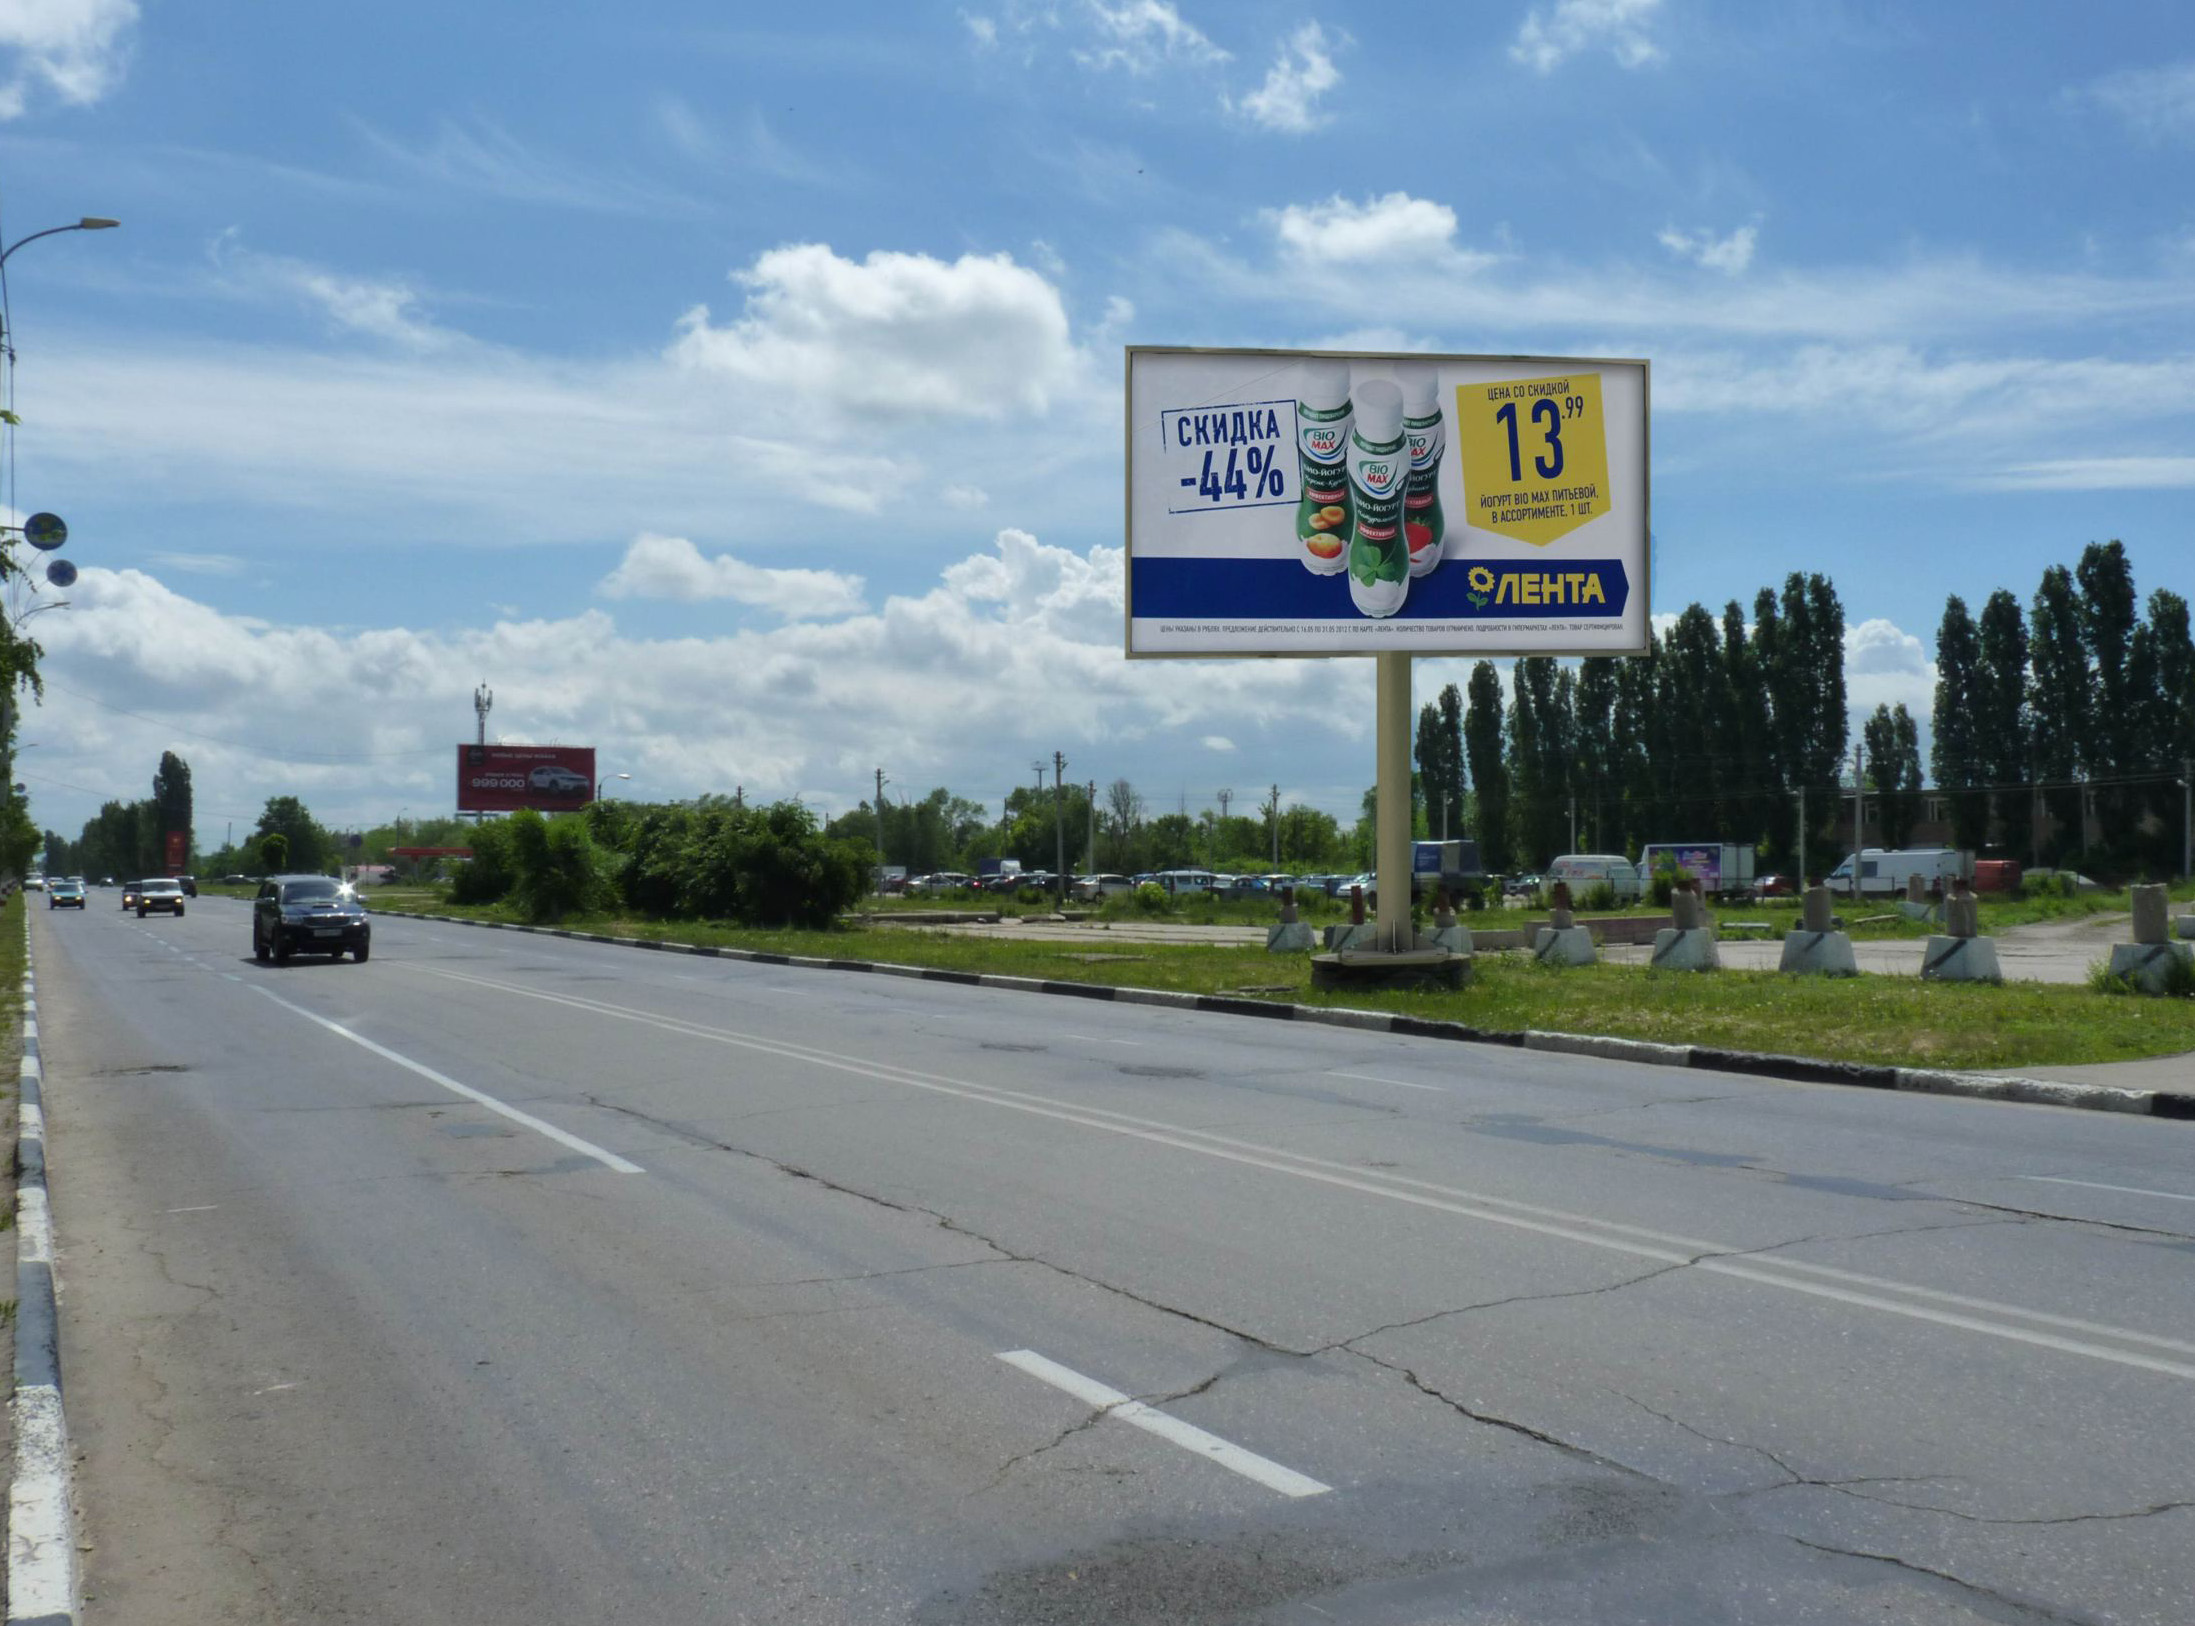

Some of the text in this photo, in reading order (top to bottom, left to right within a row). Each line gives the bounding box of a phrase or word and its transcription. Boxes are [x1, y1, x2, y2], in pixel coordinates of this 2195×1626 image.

[1487, 379, 1570, 402] ЦЕНА СО СКИДКОЙ
[1177, 409, 1281, 447] СКИДКА
[1313, 430, 1335, 441] BIO
[1311, 441, 1335, 450] MAX
[1496, 398, 1564, 482] 13
[1180, 444, 1284, 502] -44%
[1367, 474, 1388, 484] MAX
[1369, 464, 1388, 475] BIO
[1480, 483, 1599, 509] ЙОГУРТ BIO MAX ПИТЬЕВОЙ,
[1492, 511, 1498, 524] В
[1571, 503, 1575, 516] 1
[1578, 502, 1593, 515] ШТ.
[1495, 573, 1606, 604] ЛЕНТА
